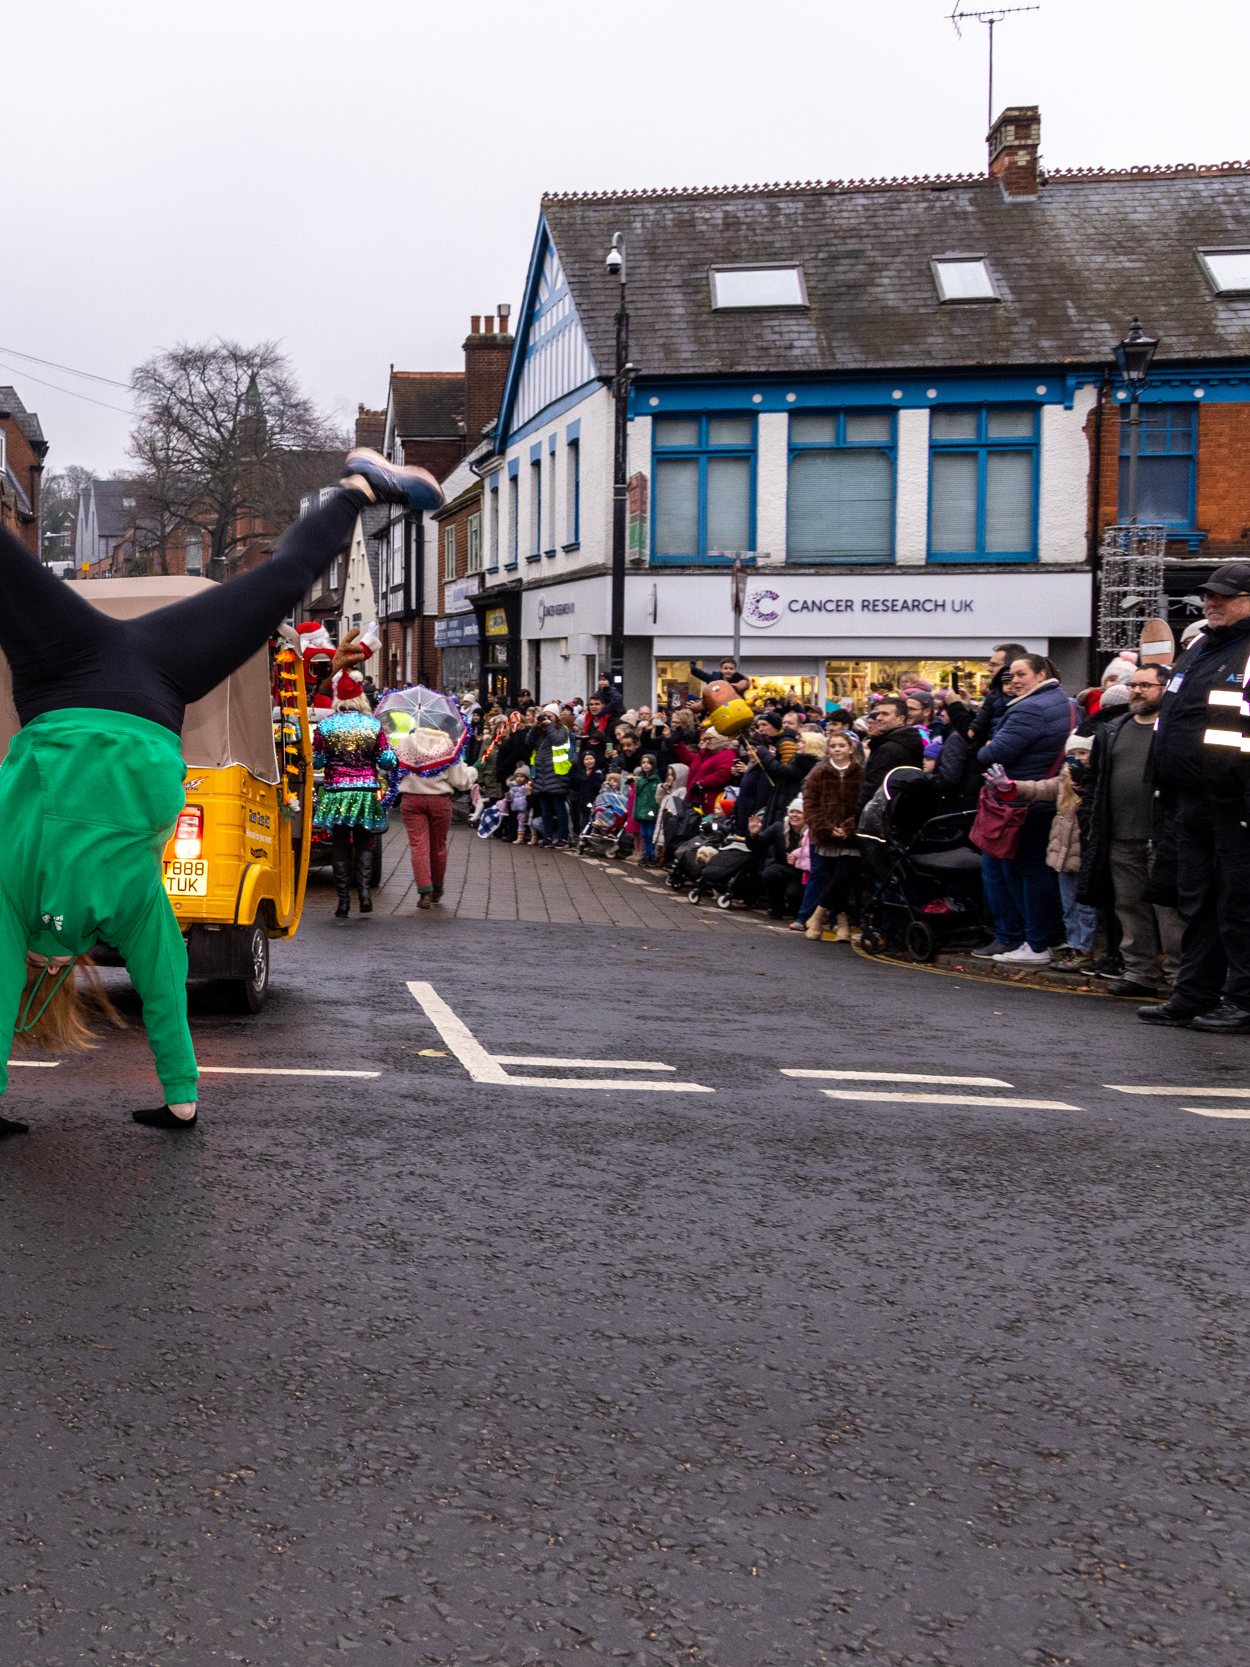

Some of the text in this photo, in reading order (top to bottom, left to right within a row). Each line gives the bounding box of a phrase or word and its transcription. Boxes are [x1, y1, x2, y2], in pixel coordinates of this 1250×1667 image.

[788, 599, 974, 612] CANCER RESEARCH UK
[163, 861, 205, 876] T888
[166, 877, 198, 892] TUK
